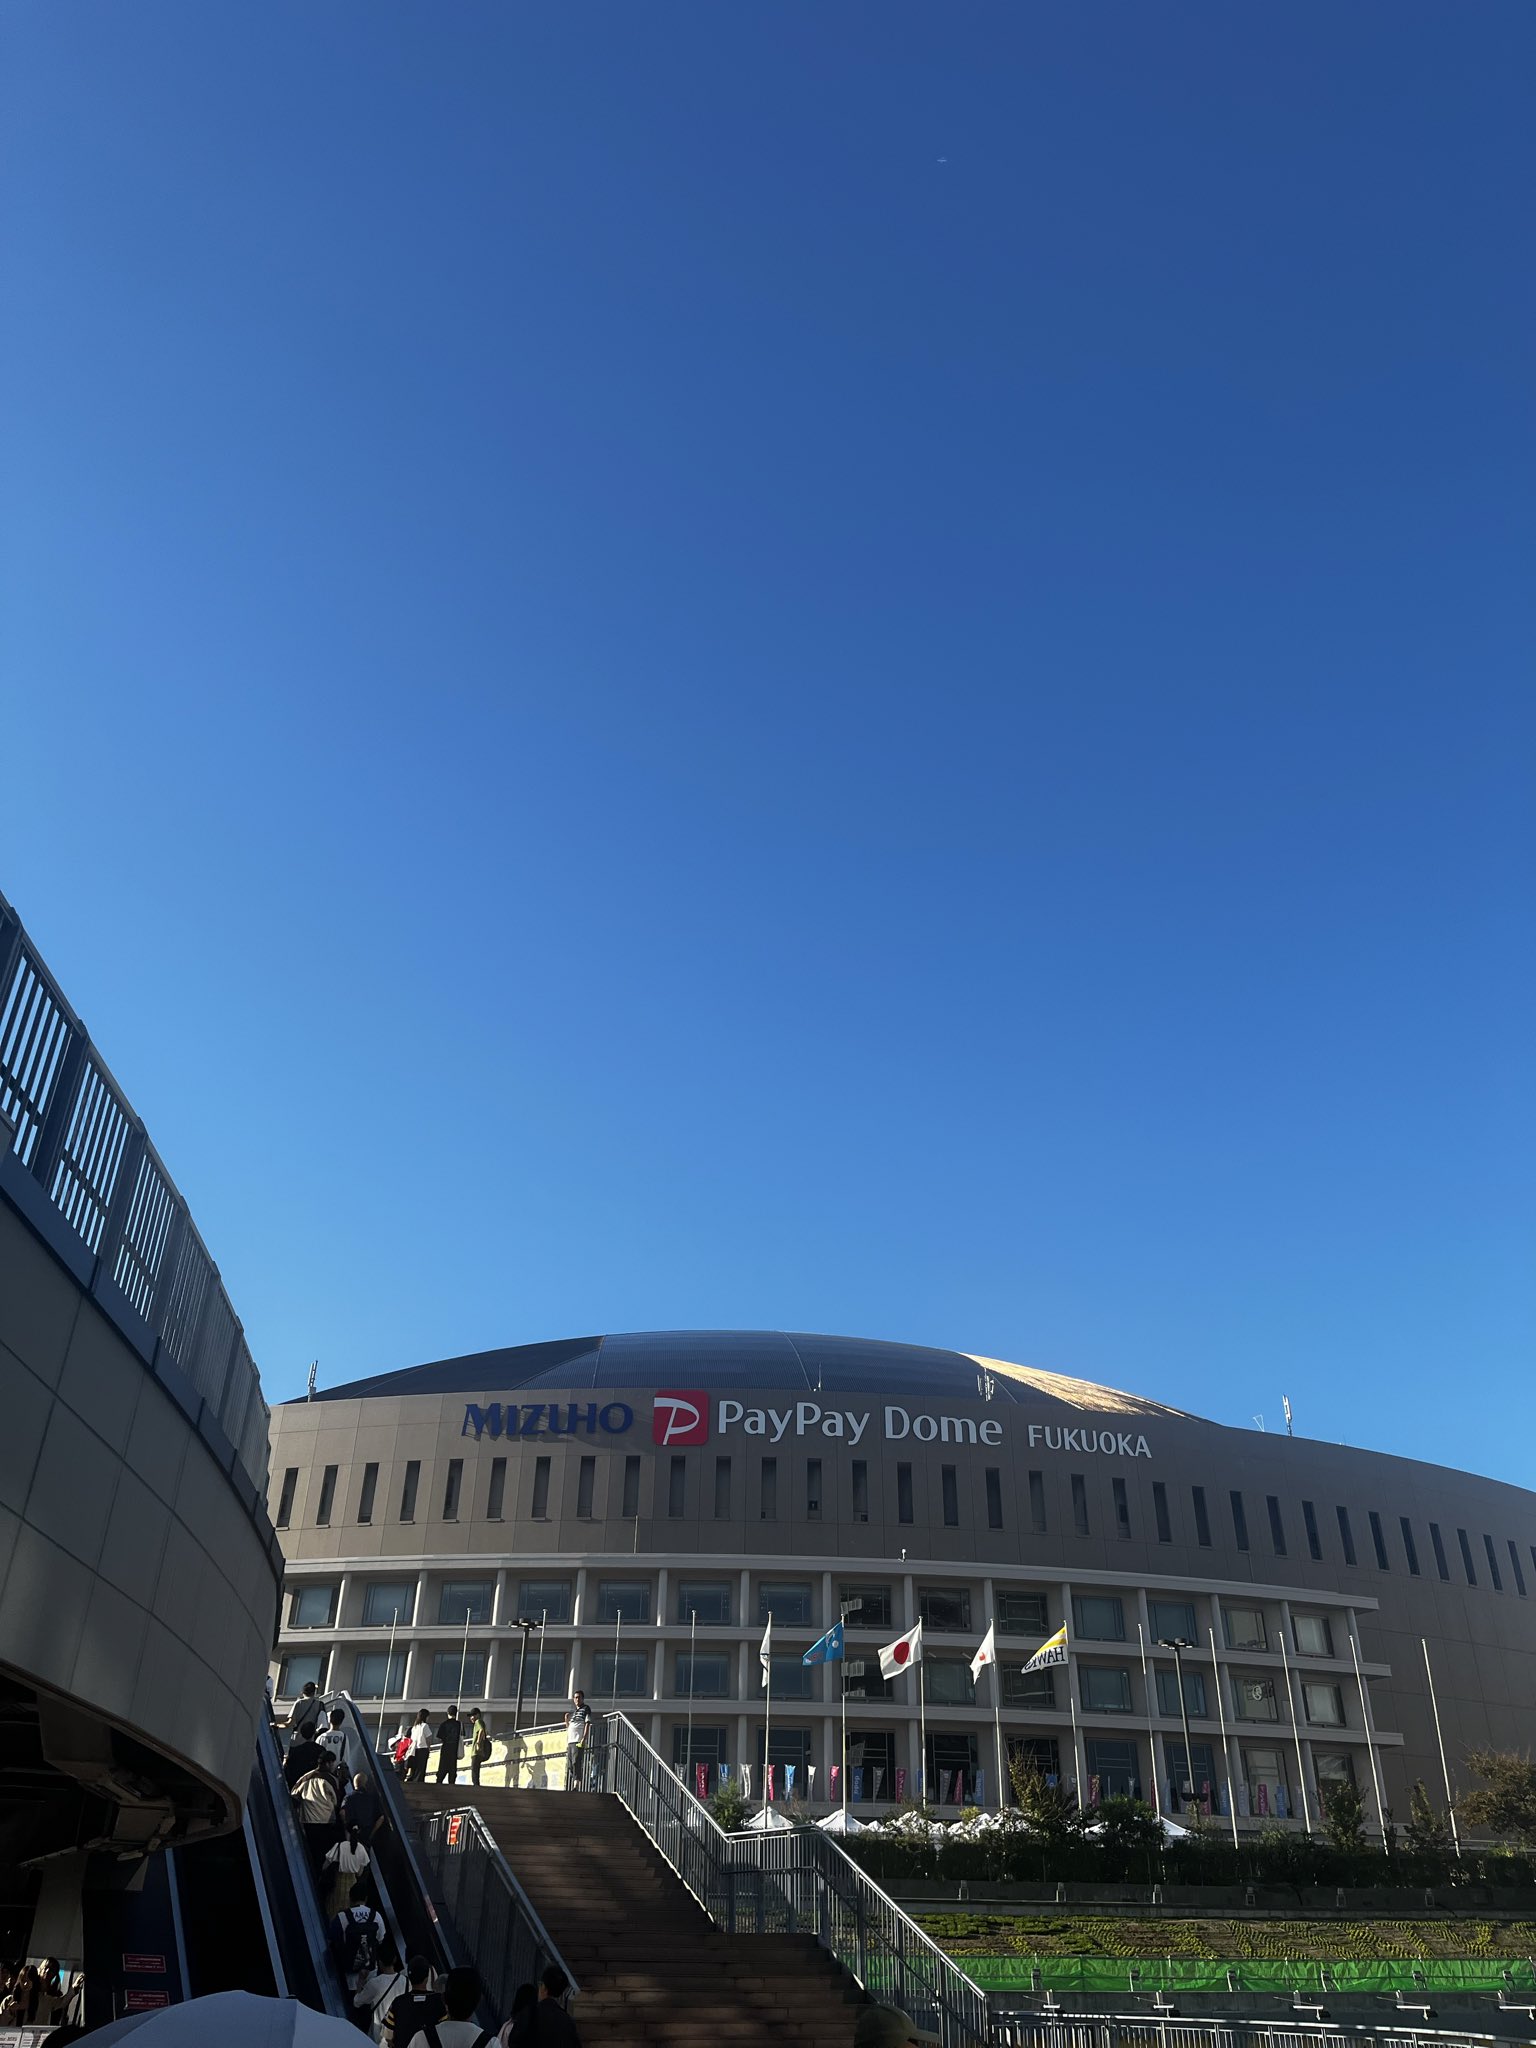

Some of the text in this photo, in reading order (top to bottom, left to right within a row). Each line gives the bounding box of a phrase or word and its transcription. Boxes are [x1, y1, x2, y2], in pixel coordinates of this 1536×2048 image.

[461, 1402, 635, 1437] MIZUHO
[718, 1400, 871, 1446] PayPay
[885, 1405, 1003, 1446] Dome
[1027, 1424, 1153, 1459] FUKUOKA
